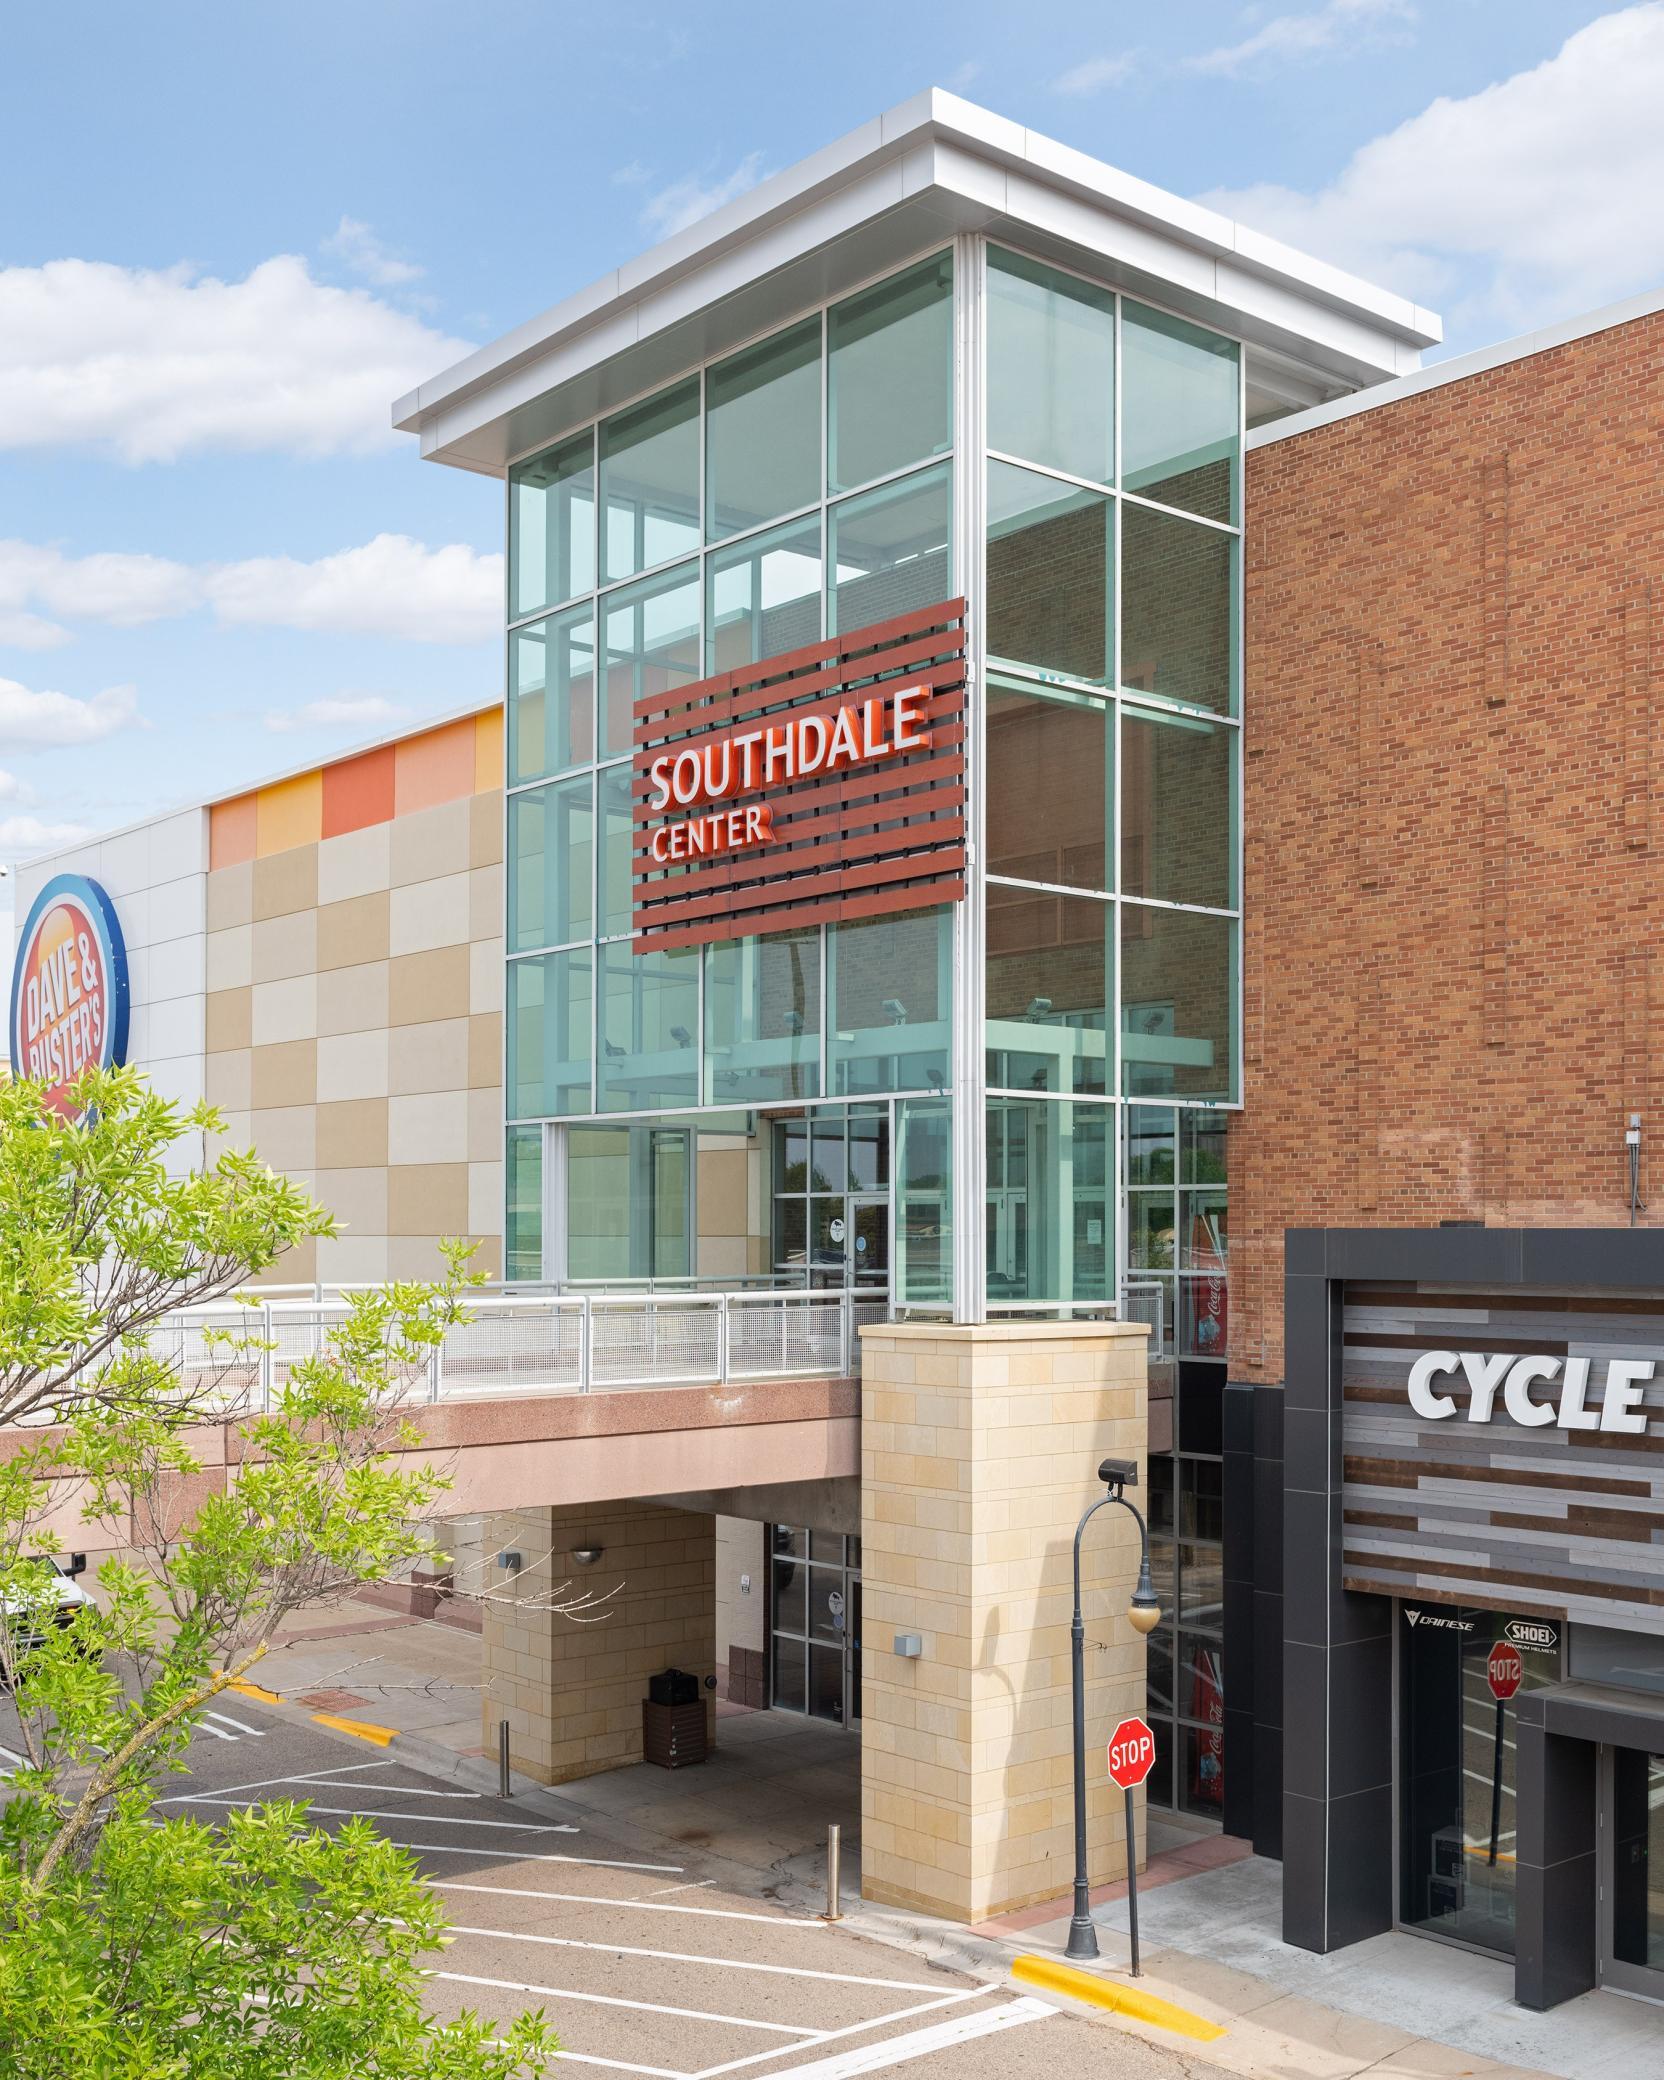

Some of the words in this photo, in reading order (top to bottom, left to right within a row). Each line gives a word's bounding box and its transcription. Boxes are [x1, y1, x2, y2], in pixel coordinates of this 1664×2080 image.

[651, 684, 931, 812] SOUTHDALE
[652, 804, 776, 864] CENTER
[27, 938, 81, 1042] DAVE
[78, 931, 99, 993] &
[29, 992, 101, 1093] BUSTER'S
[1408, 1350, 1656, 1434] CYCLE
[1419, 1616, 1475, 1632] DAINESE
[1512, 1624, 1551, 1644] SHOEI
[1111, 1736, 1151, 1771] STOP
